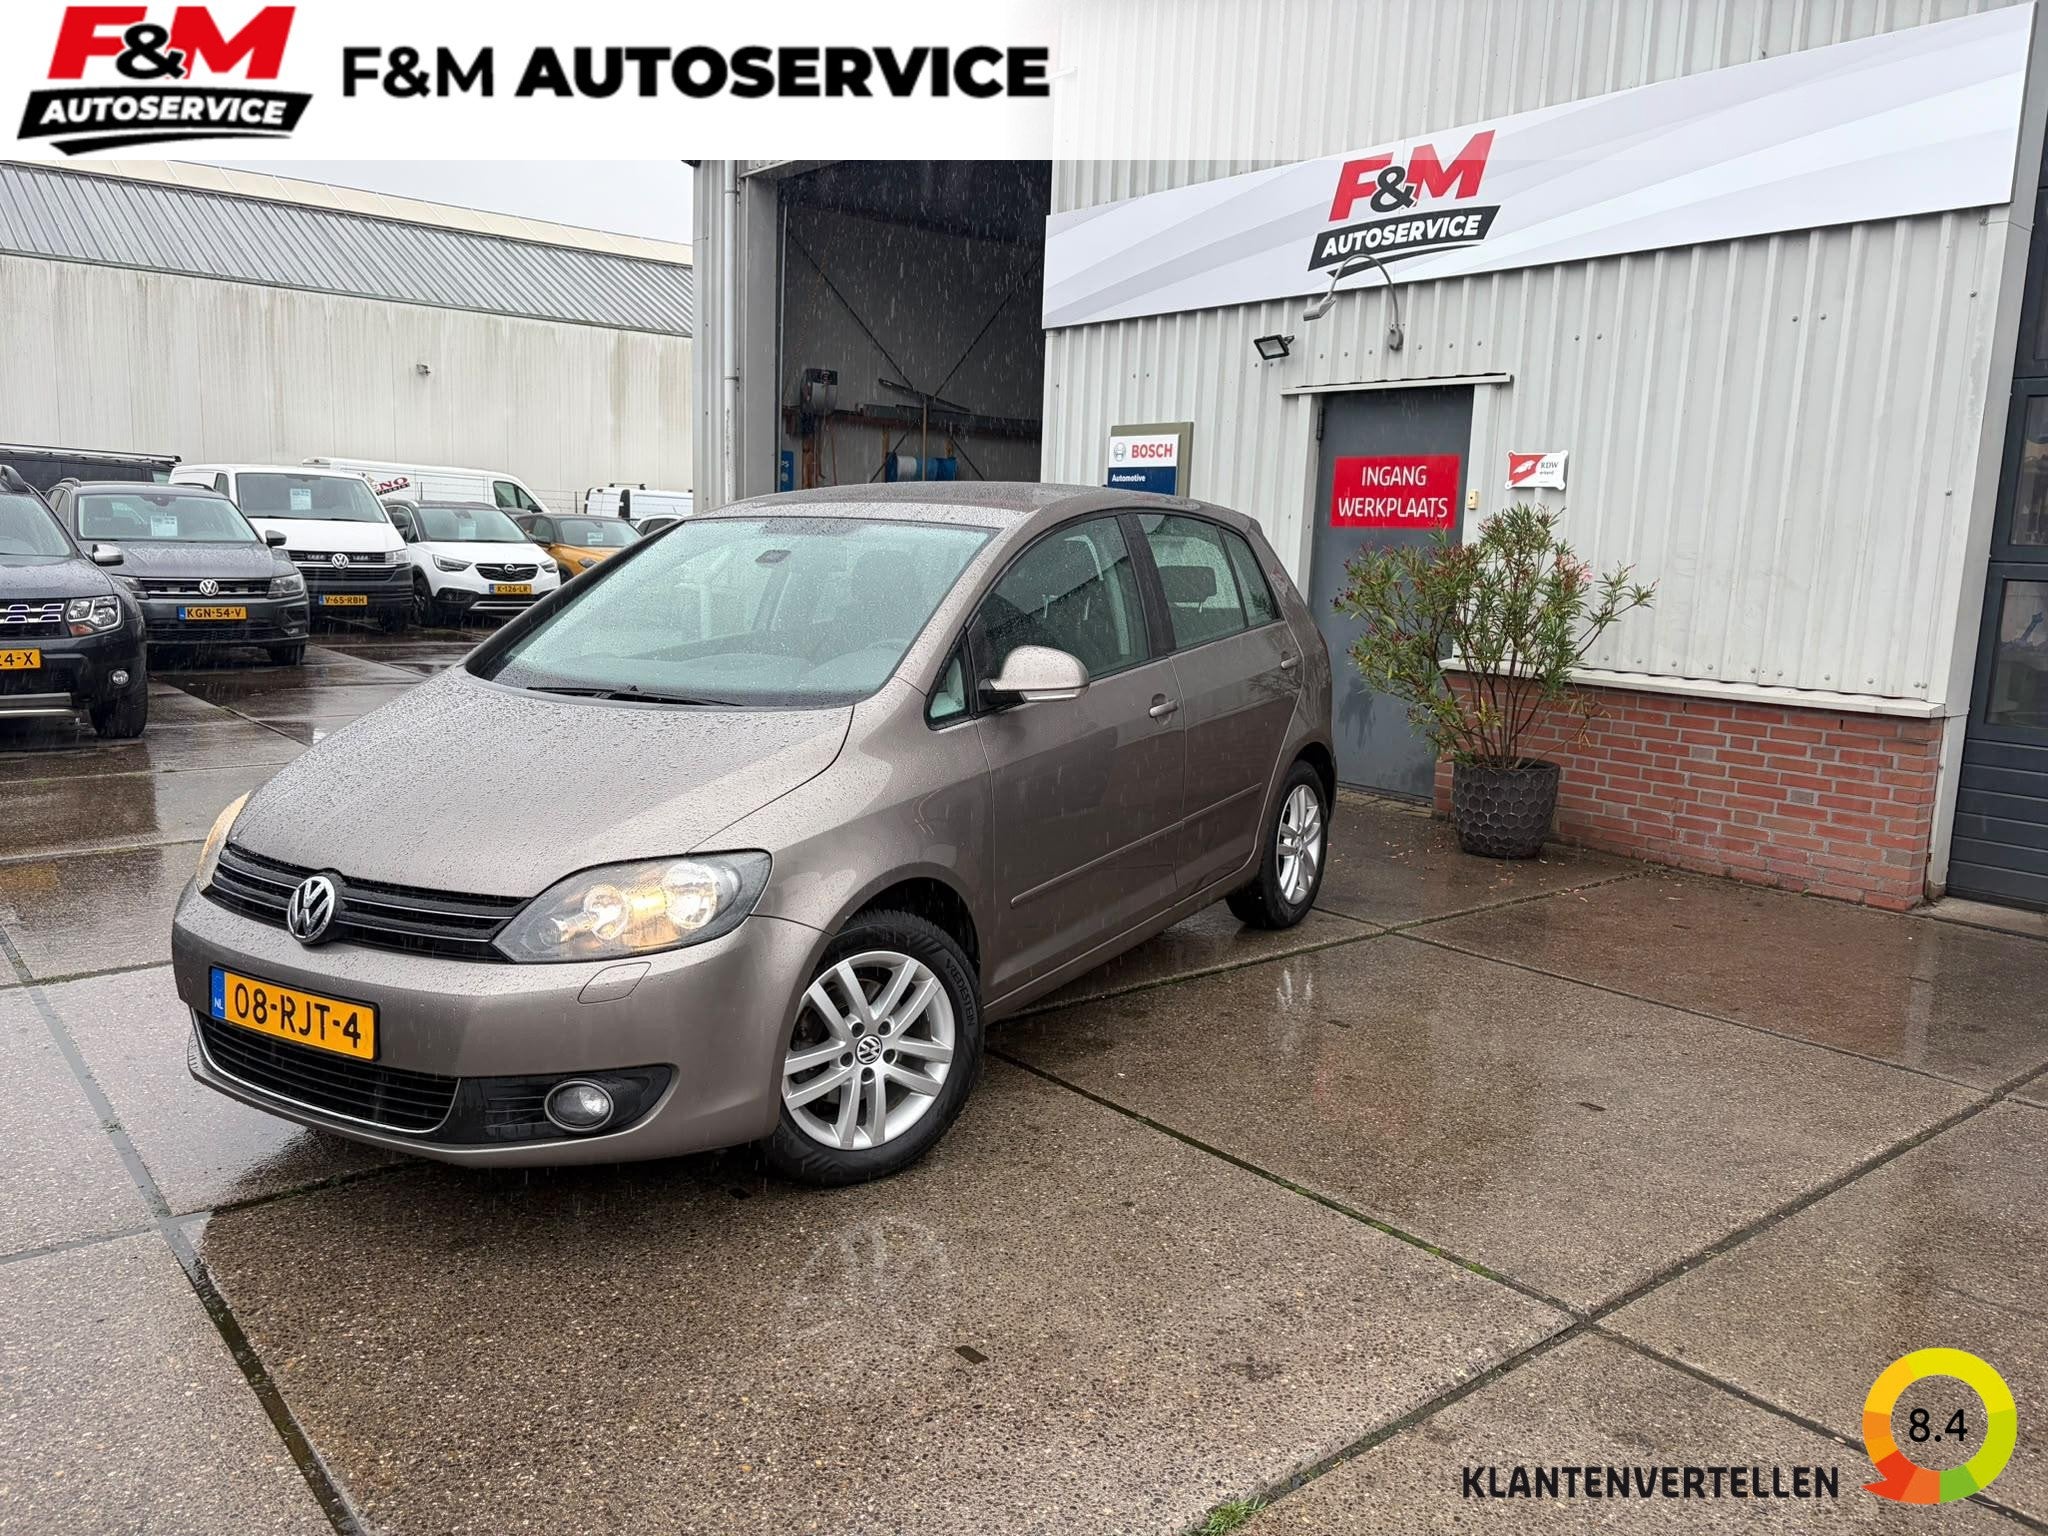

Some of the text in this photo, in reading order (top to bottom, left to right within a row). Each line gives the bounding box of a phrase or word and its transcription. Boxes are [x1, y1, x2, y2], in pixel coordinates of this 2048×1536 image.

[1329, 130, 1496, 222] F&M
[1321, 215, 1482, 259] AUTOSERVICE
[1131, 444, 1173, 458] BOSCH
[1112, 474, 1146, 482] Automotive
[1361, 465, 1427, 486] INGANG
[1338, 497, 1448, 518] WERKPLAATS
[186, 608, 242, 618] KGN-54-V
[0, 652, 34, 666] 4-X
[214, 997, 224, 1010] NL
[234, 983, 361, 1048] 08-RJT-4
